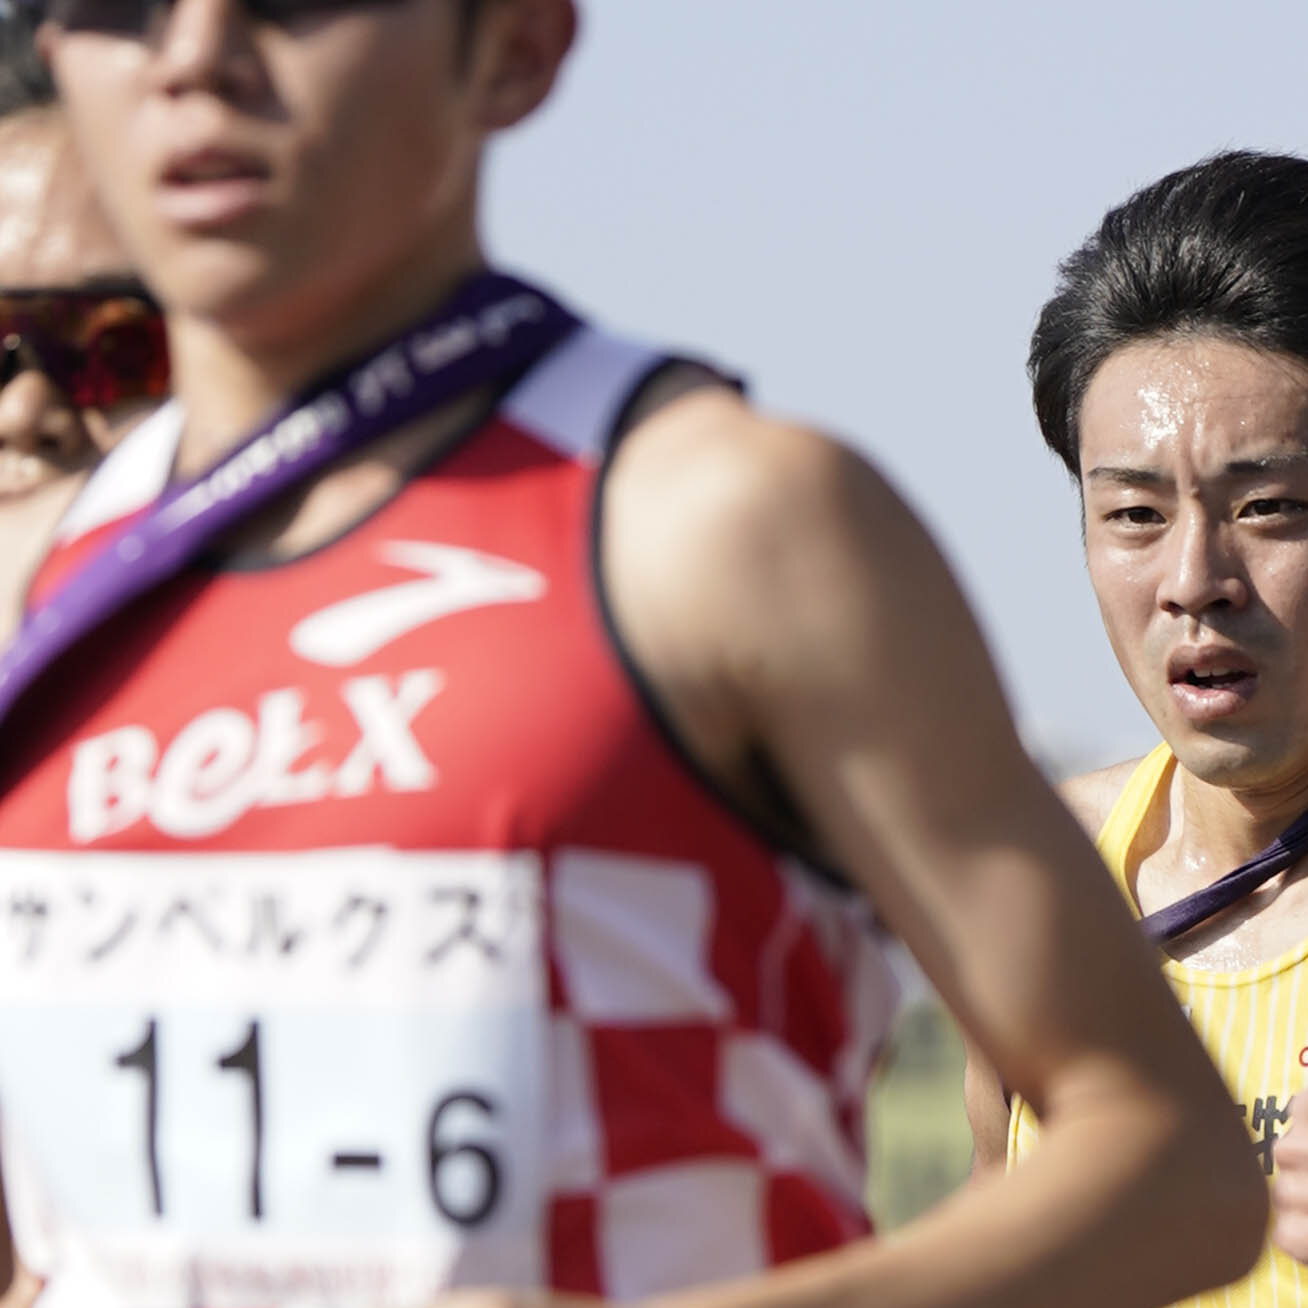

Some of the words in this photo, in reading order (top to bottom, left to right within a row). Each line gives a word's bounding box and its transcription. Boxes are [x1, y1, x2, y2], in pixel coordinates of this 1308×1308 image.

[8, 884, 503, 968] サンベルクス
[113, 1018, 506, 1228] 11-6
